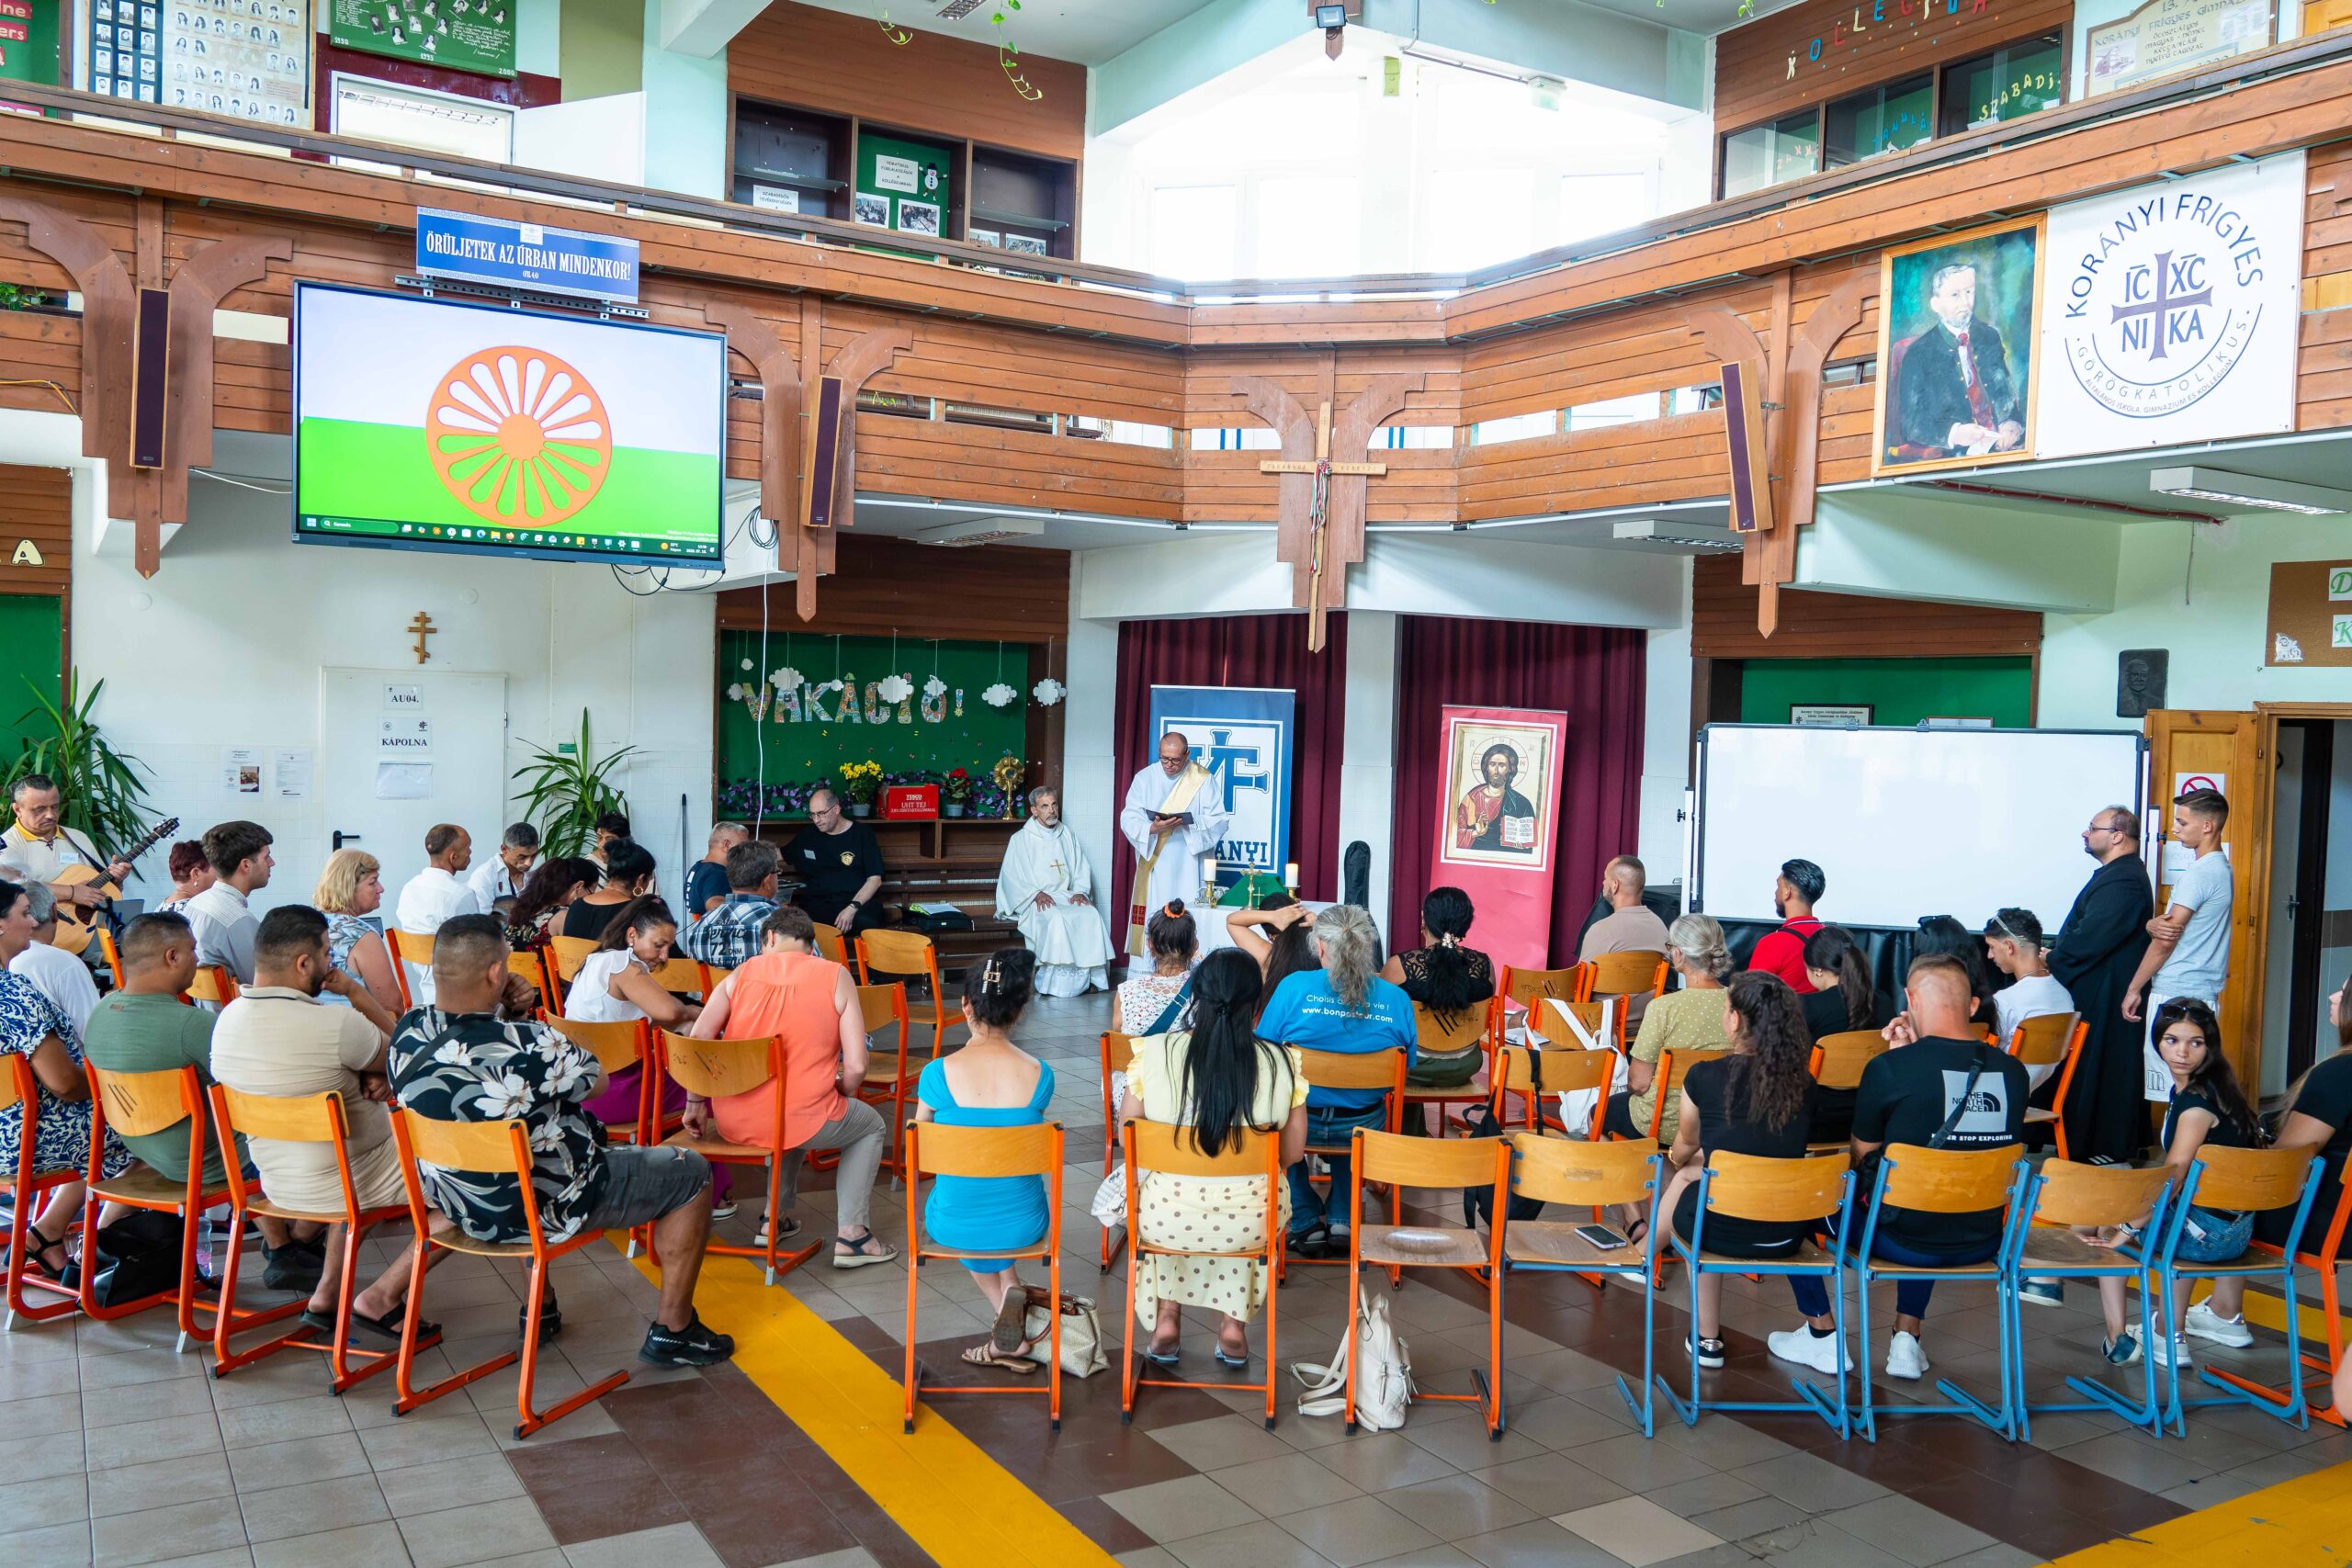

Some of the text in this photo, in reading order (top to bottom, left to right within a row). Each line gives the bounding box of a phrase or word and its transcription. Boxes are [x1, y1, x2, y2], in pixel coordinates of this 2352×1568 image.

[2149, 10, 2190, 30] FRIGYES
[498, 67, 515, 76] 2000
[426, 231, 495, 262] ÖRÜLJETEK
[499, 244, 514, 265] AZ
[517, 244, 559, 271] ÚRBAN
[560, 253, 631, 281] MINDENKOR!
[2065, 194, 2263, 318] KORÁNYI FRIGYES
[11, 538, 44, 566] A
[382, 737, 427, 747] KÁPOLNA
[710, 942, 727, 955] 72
[1306, 995, 1335, 1004] Choisis
[1931, 1133, 1956, 1141] NER
